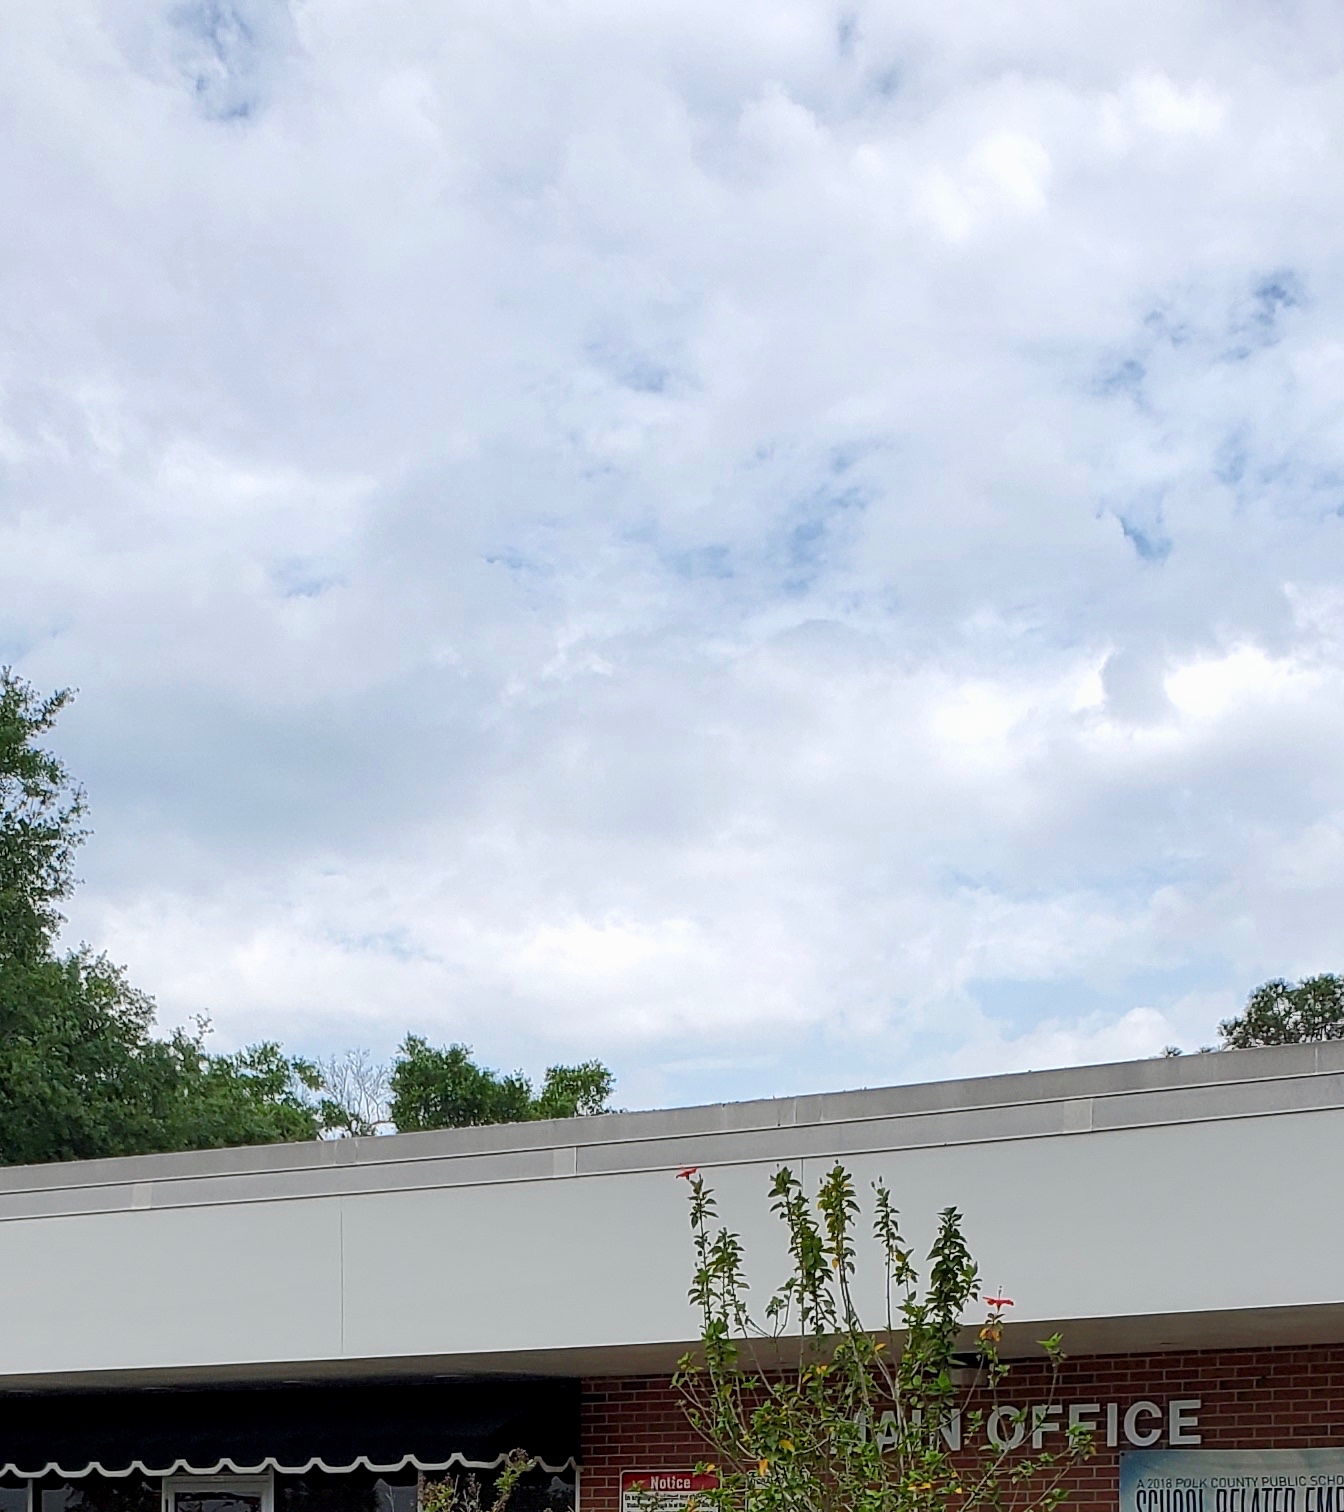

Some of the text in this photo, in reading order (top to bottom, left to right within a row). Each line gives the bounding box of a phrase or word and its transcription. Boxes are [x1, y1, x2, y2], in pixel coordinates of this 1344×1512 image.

[986, 1399, 1203, 1451] OFFICE
[650, 1475, 691, 1490] Notice
[1136, 1478, 1146, 1489] A
[1147, 1477, 1173, 1489] 2018
[1176, 1477, 1208, 1488] POLK
[1211, 1476, 1258, 1488] COUNTY
[1262, 1475, 1307, 1487] PUBLIC
